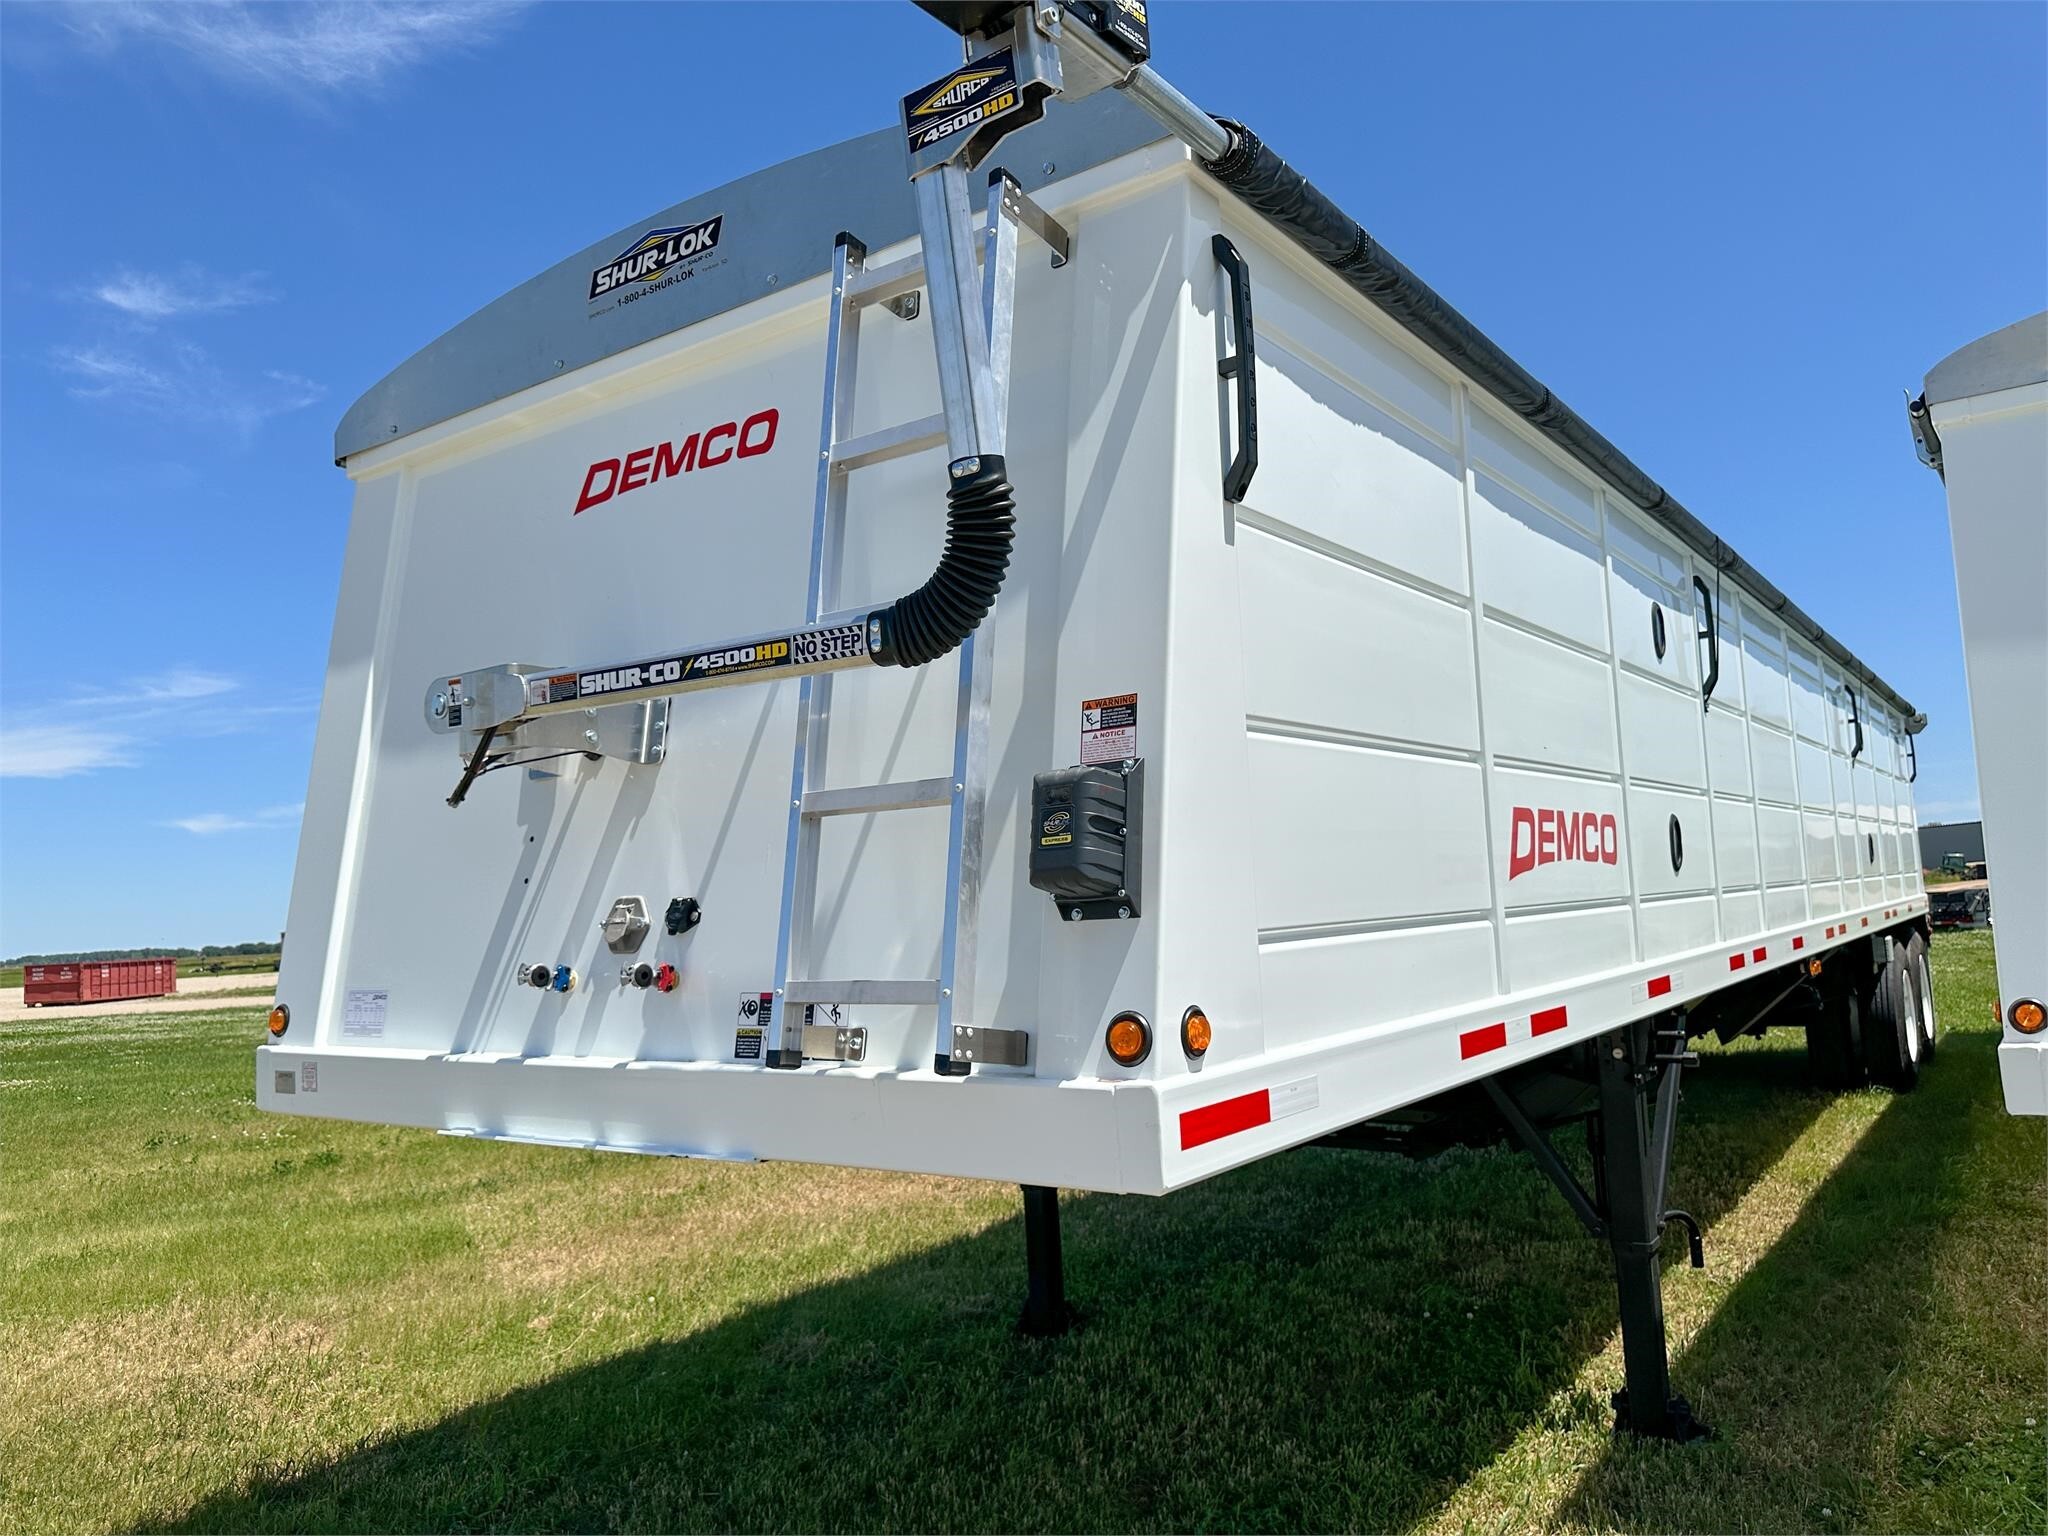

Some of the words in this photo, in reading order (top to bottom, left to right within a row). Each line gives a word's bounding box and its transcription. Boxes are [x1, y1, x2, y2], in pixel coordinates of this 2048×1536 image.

[932, 76, 990, 108] SHURCO
[923, 93, 1014, 143] 4500HD
[594, 222, 717, 294] SHUR-LOK
[617, 267, 696, 308] 1-800-4-SHUR-LOK
[573, 408, 780, 517] DEMCO
[794, 639, 818, 657] NO
[819, 632, 862, 652] STEP
[580, 659, 681, 696] SHUR-CO
[693, 641, 789, 671] 4500HD
[1094, 695, 1135, 709] WARNING
[1100, 730, 1126, 739] NOTICE
[1508, 806, 1618, 882] DEMCO
